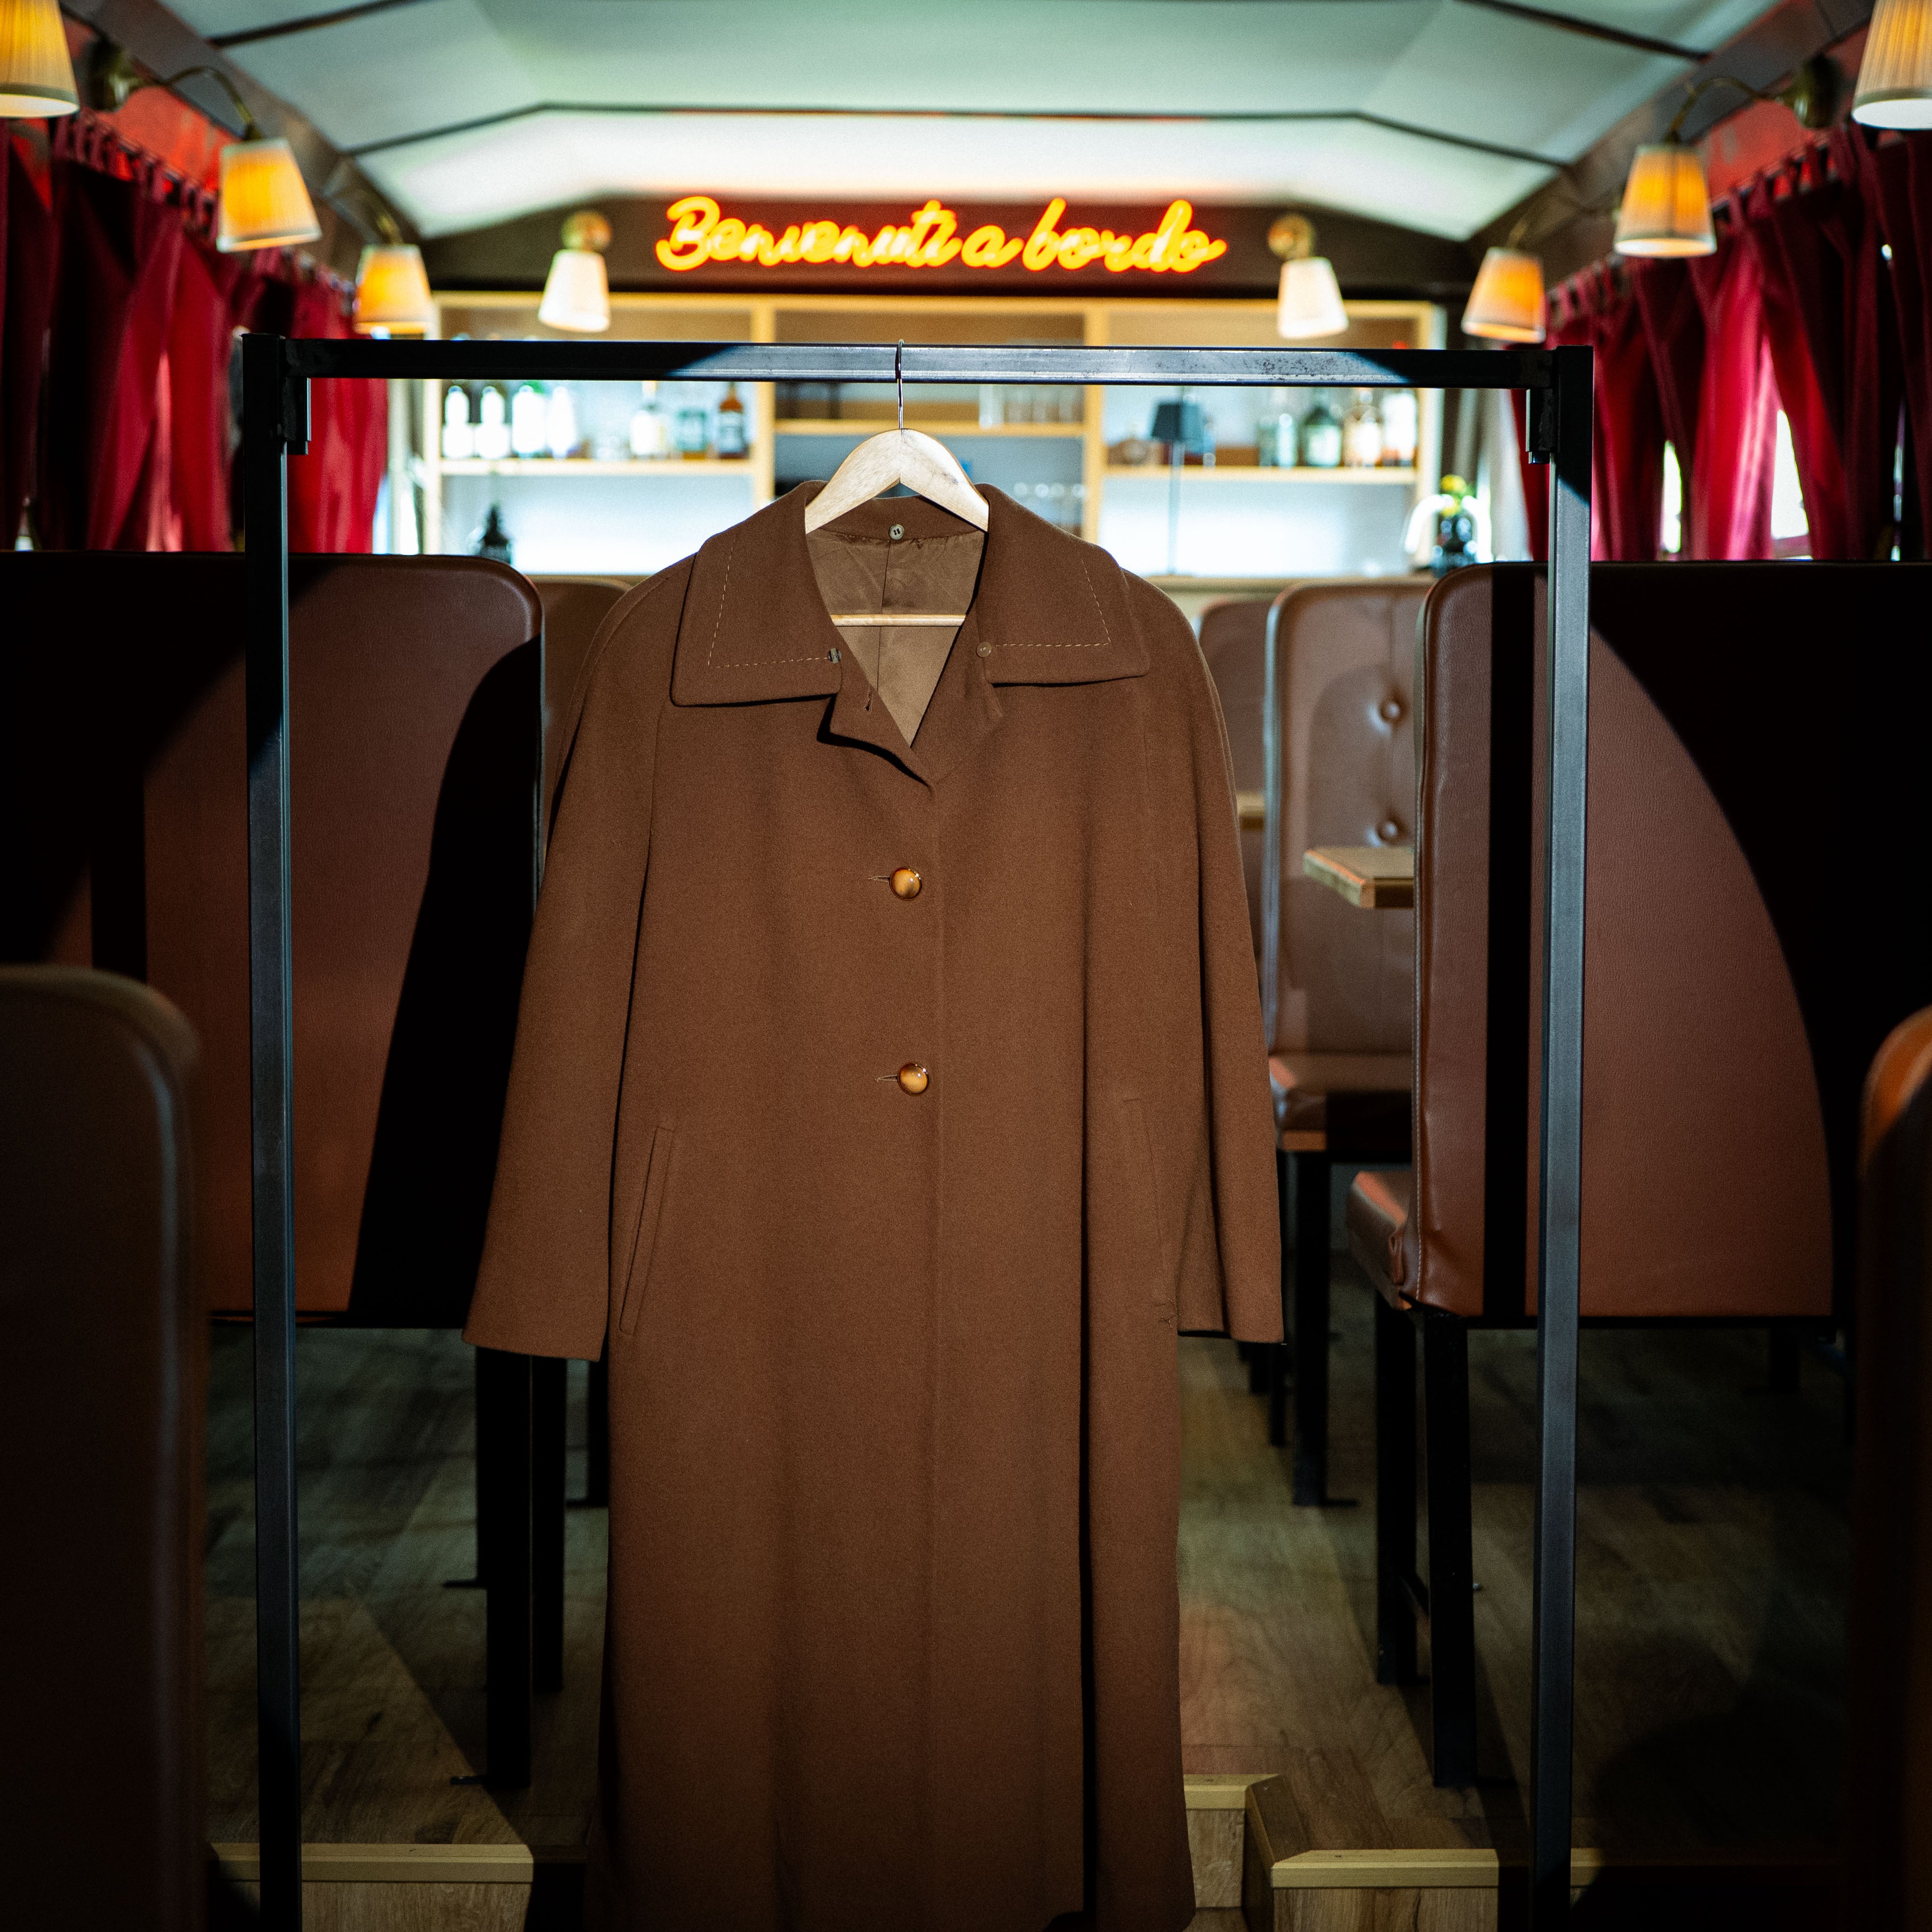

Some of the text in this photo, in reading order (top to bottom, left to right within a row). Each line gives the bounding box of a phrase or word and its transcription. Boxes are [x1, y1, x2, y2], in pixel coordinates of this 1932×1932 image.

[656, 195, 1228, 273] Benvenuti a bordo
